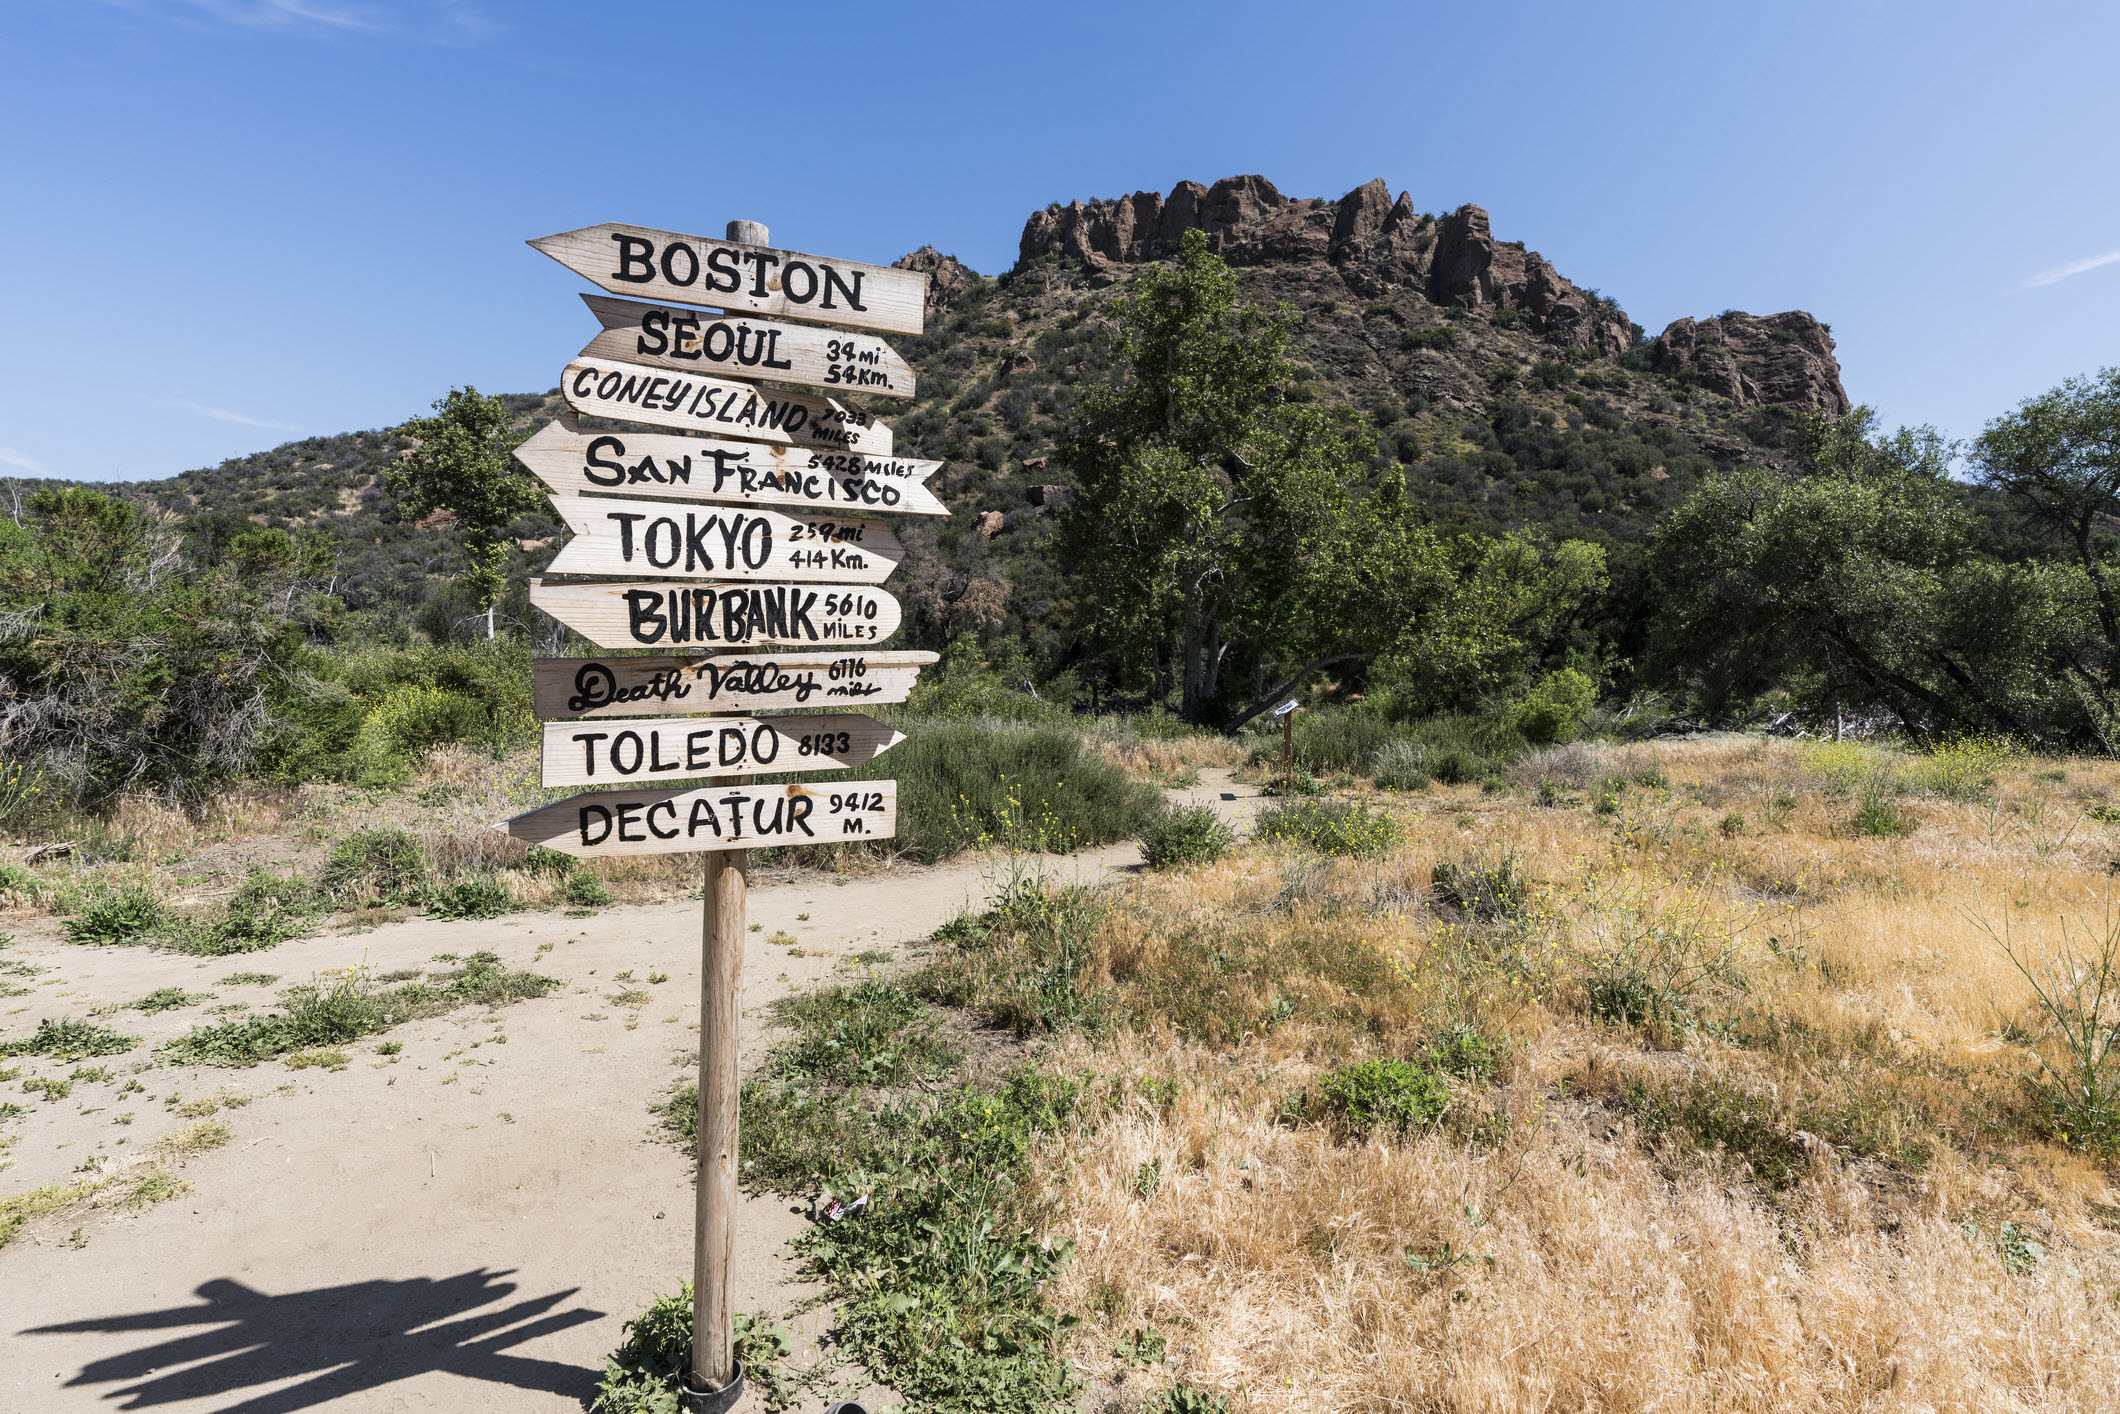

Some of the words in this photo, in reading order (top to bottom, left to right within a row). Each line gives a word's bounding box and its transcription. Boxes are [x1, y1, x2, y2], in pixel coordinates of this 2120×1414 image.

[611, 233, 868, 312] BOSTON
[637, 311, 791, 370] SEOUL
[826, 339, 857, 362] 34
[823, 363, 858, 384] 54
[573, 367, 692, 412] CONEY
[689, 386, 809, 433] ISLAND
[821, 408, 867, 426] 7033
[811, 427, 860, 445] MILES
[807, 454, 860, 476] 5428
[607, 513, 773, 572] TOKYO
[788, 522, 835, 543] 259
[837, 523, 866, 542] mi
[788, 549, 829, 570] 414
[622, 586, 819, 644] BURBANK
[824, 593, 878, 620] 5610
[568, 663, 690, 711] Death
[696, 660, 823, 702] Valley
[572, 724, 779, 776] TOLEDO
[797, 732, 850, 756] 8133
[829, 792, 885, 815] 9412
[578, 795, 814, 847] DECATUR
